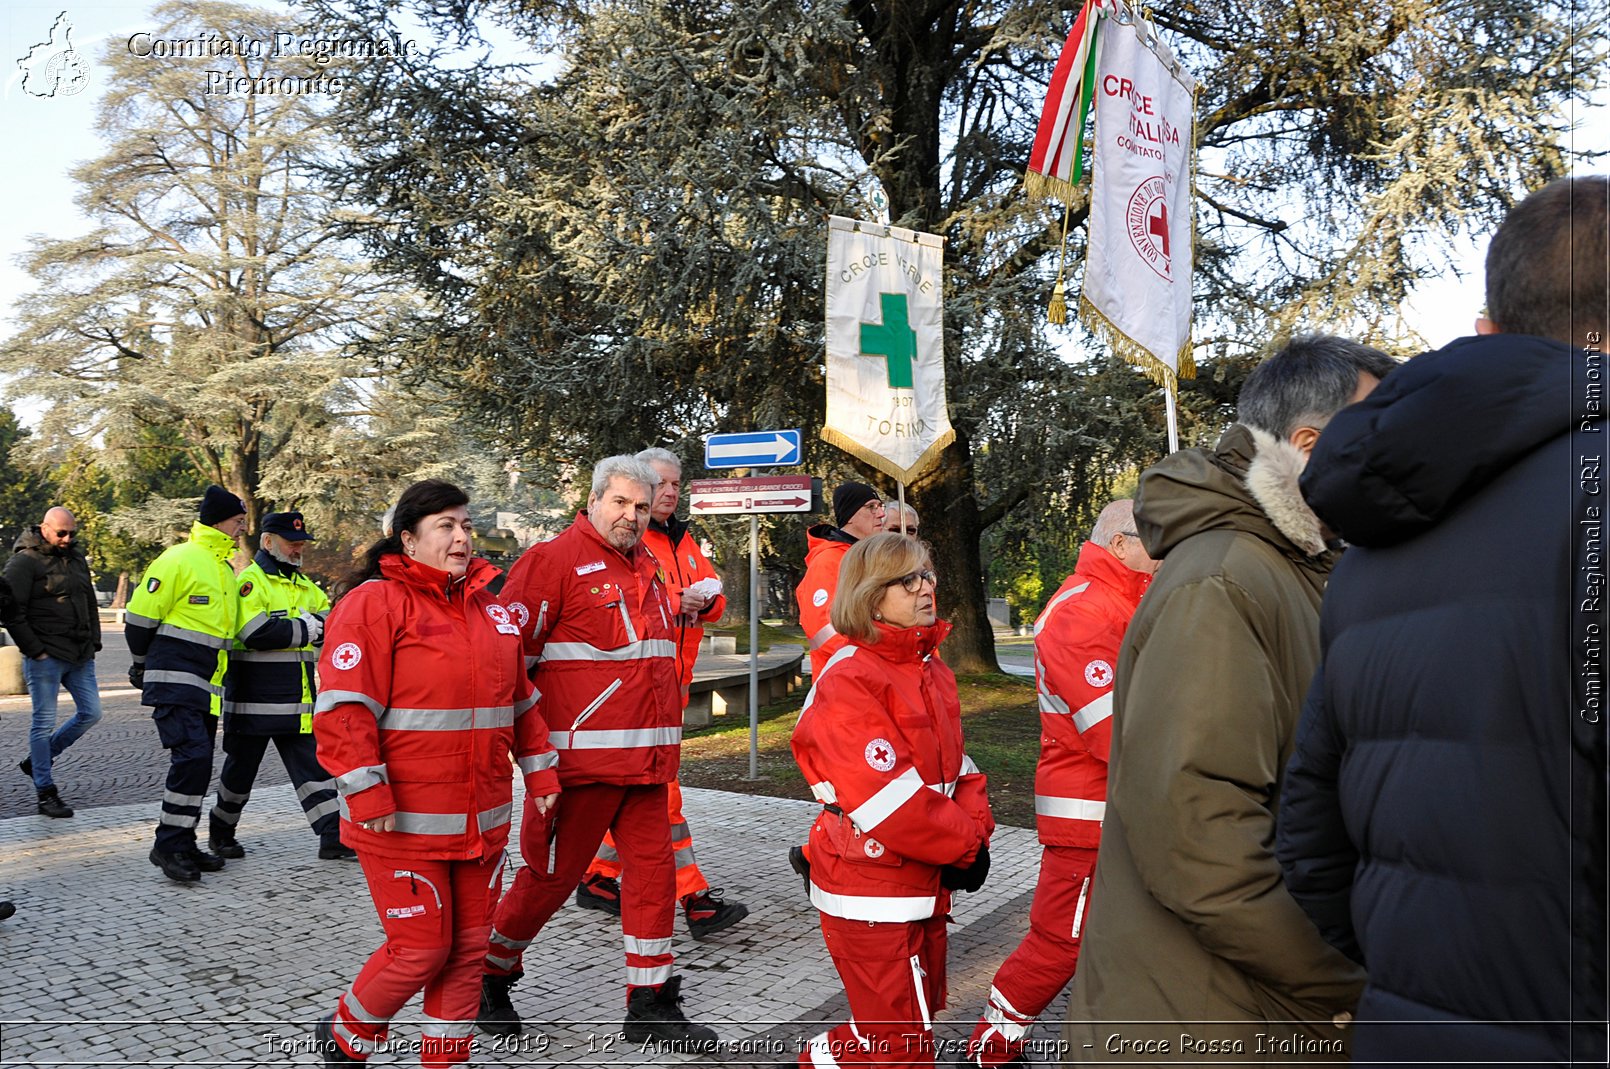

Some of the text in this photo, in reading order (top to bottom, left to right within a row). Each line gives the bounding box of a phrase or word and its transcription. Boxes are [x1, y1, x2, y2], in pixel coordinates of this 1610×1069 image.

[1117, 136, 1162, 160] COMITATO
[1130, 192, 1158, 263] CONVENZIONE
[841, 252, 933, 294] CROCE VERDE
